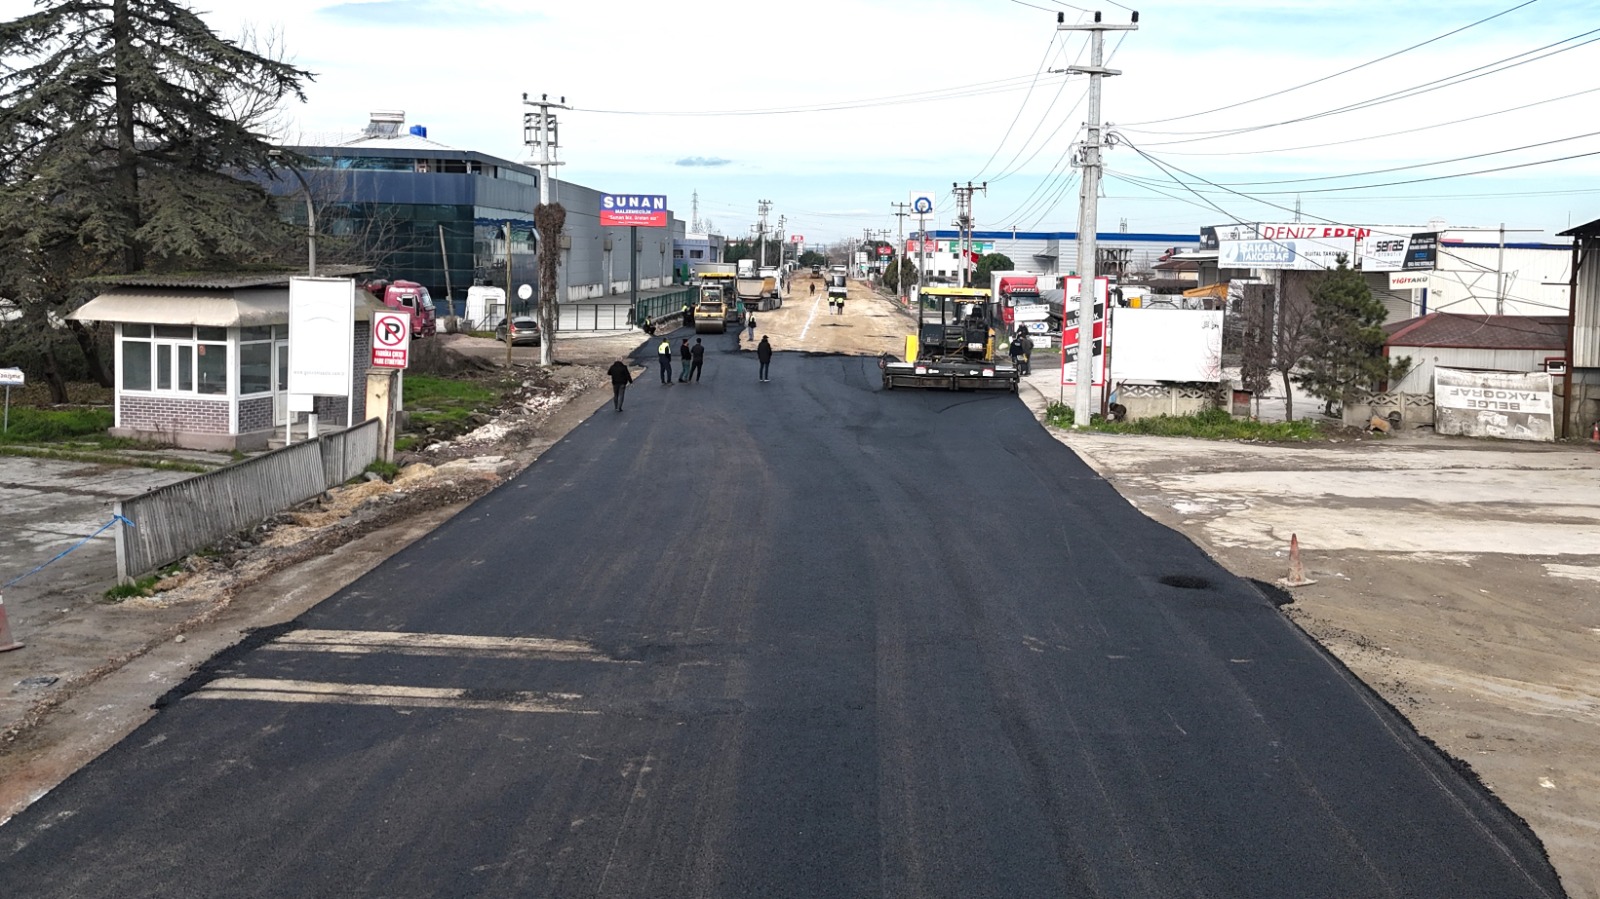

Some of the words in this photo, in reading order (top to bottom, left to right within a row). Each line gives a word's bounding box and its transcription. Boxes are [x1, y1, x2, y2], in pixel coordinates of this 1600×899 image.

[603, 196, 664, 209] SUNAN
[1240, 243, 1289, 253] SAKARYA
[1242, 252, 1289, 262] TAKOGRAF
[1450, 388, 1541, 401] TAKOGRAF
[1467, 399, 1521, 411] BELGE
